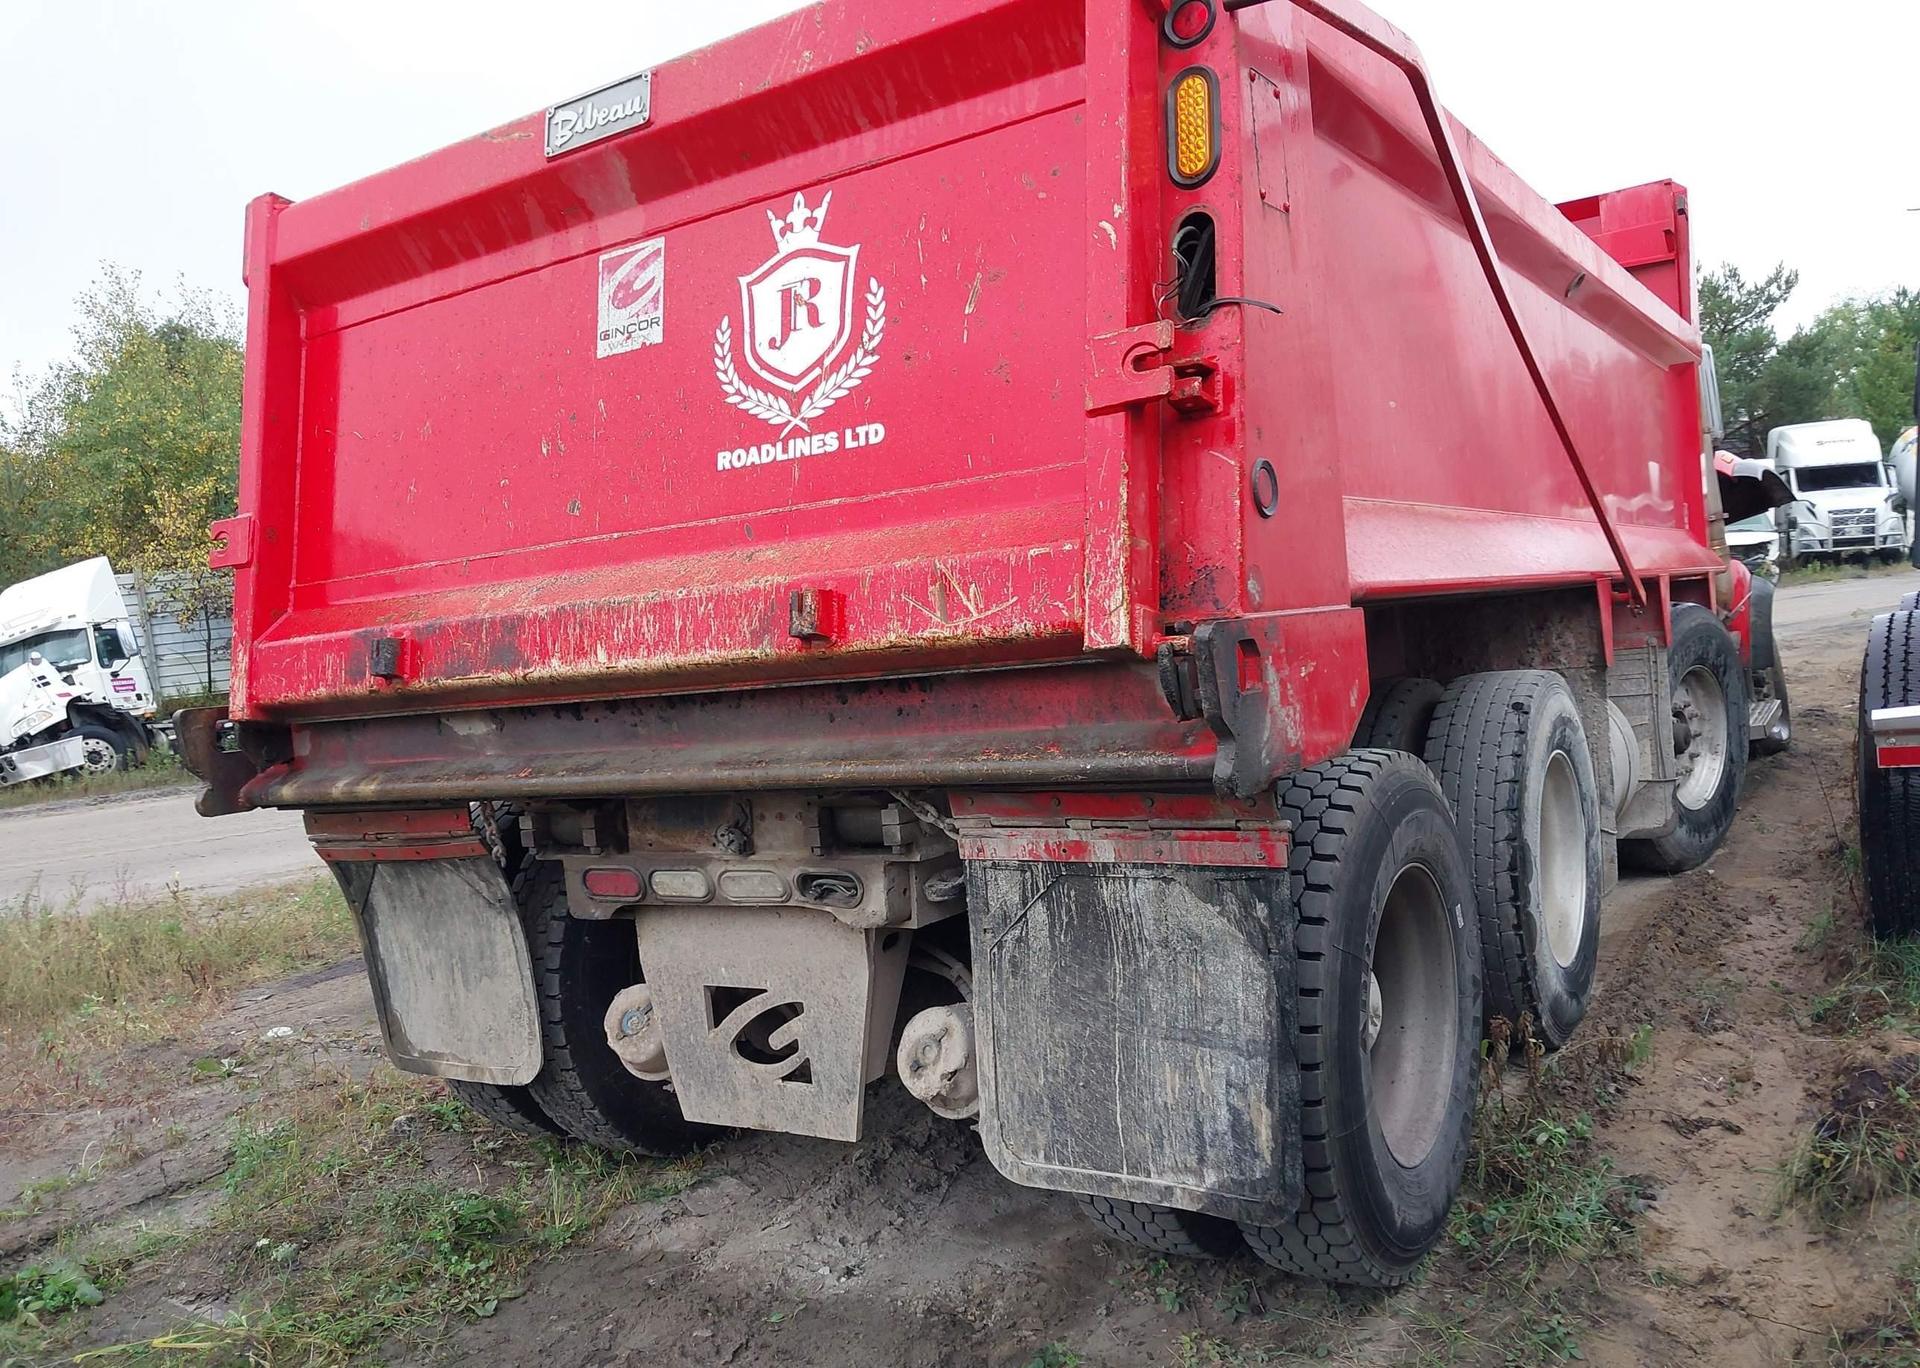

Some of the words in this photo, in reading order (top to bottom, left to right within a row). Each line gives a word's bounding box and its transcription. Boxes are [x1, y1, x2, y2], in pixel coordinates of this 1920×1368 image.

[553, 96, 644, 148] Bibeau
[599, 316, 661, 342] GINCOR
[716, 431, 840, 472] ROADLINES
[844, 422, 886, 449] LTD
